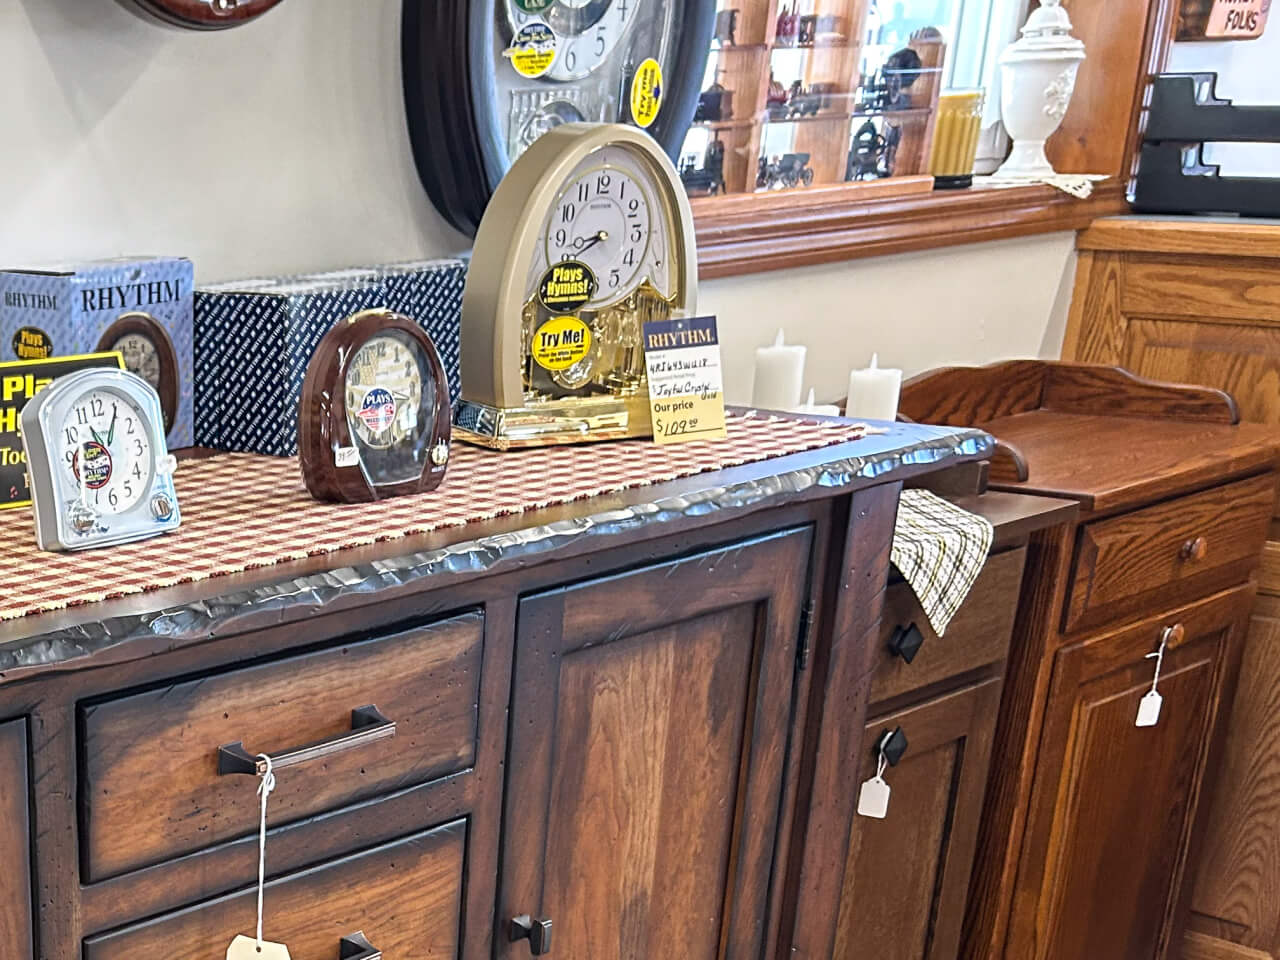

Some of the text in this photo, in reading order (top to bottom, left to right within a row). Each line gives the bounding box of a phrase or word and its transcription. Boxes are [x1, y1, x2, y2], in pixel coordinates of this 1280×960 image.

[1225, 9, 1259, 31] FOLKS
[594, 26, 606, 56] 5
[578, 183, 589, 201] 11
[596, 175, 611, 194] 12
[620, 181, 625, 199] 1
[562, 203, 575, 223] 10
[555, 228, 566, 248] 9
[631, 223, 642, 243] 3
[623, 248, 634, 267] 4
[553, 267, 583, 282] Plays
[609, 269, 619, 288] 5
[80, 279, 182, 313] RHYTHM
[547, 279, 588, 296] Hymns!
[4, 291, 57, 310] RHYTHM
[541, 328, 584, 347] Try Me!
[648, 328, 712, 348] RHYTHM
[90, 399, 104, 417] 12
[366, 394, 391, 405] PLAYS
[654, 400, 694, 413] Our price
[75, 406, 88, 424] 11
[125, 417, 135, 434] 2
[65, 426, 78, 445] 10
[134, 439, 143, 456] 3
[132, 462, 141, 480] 4
[109, 488, 118, 506] 6
[123, 480, 132, 497] 5
